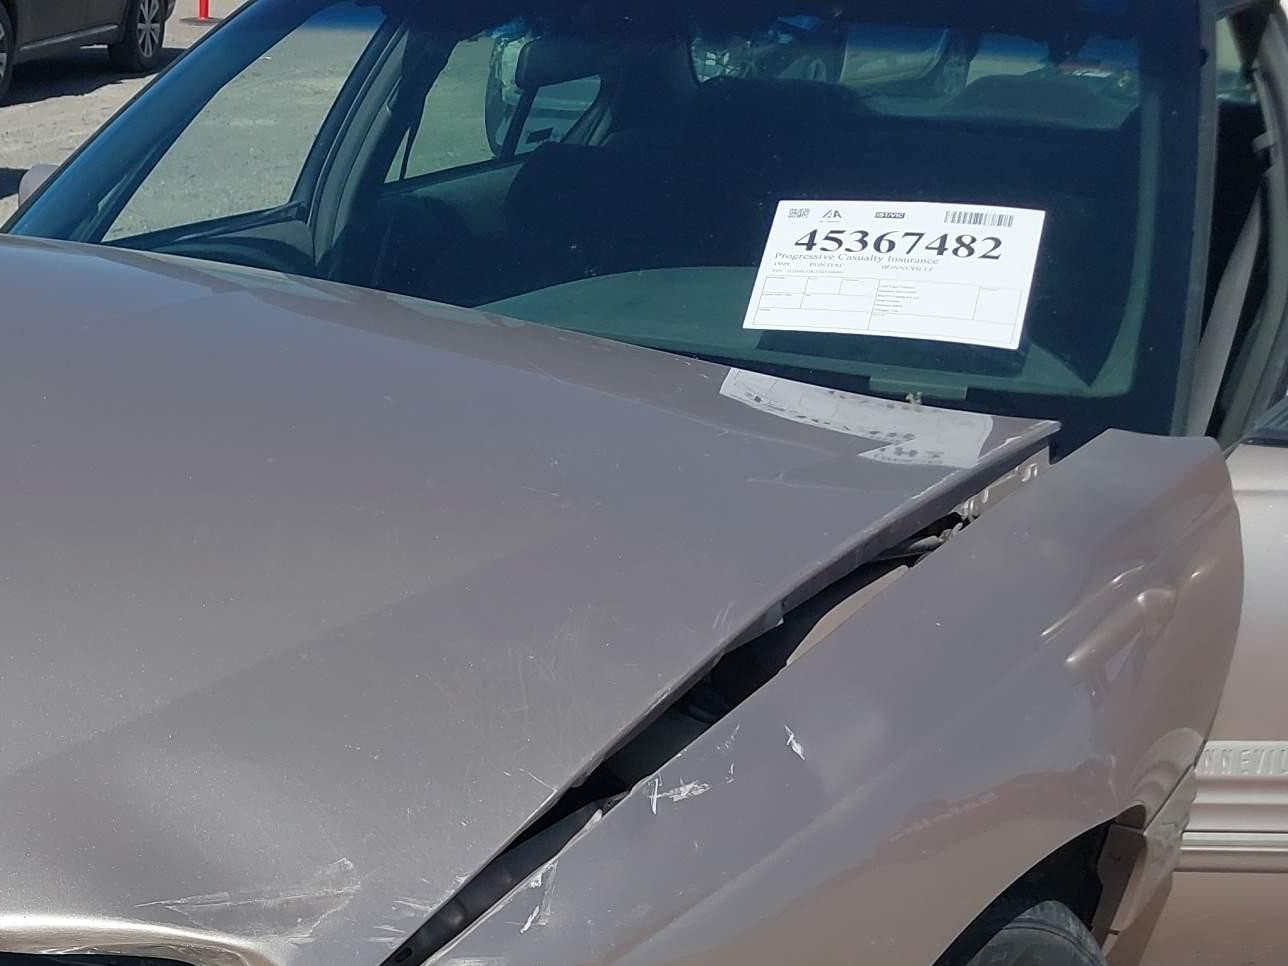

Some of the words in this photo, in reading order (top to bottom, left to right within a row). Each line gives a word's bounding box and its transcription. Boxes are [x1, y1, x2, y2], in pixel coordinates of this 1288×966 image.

[794, 228, 1003, 260] 45367482
[774, 252, 835, 262] Progressive
[837, 253, 884, 264] Casualty
[886, 255, 939, 265] Insurance
